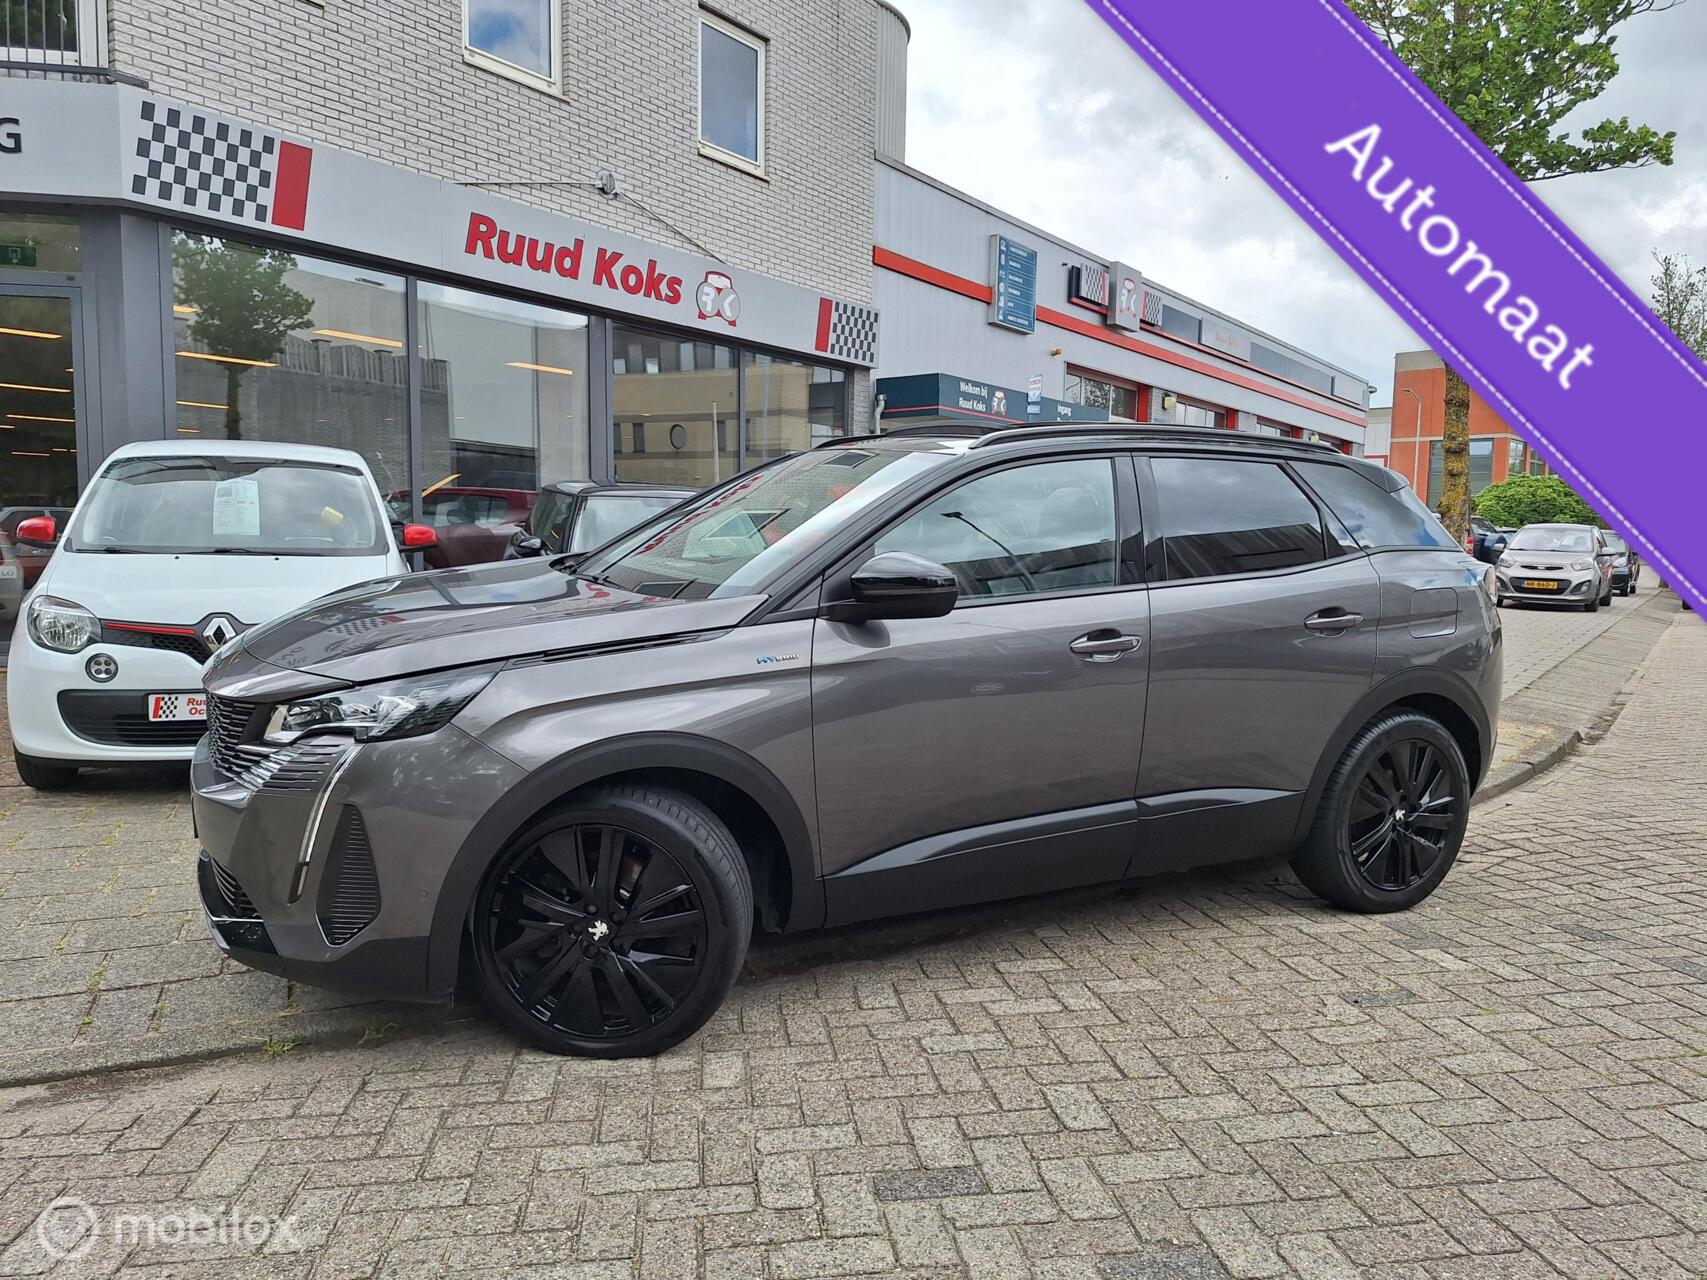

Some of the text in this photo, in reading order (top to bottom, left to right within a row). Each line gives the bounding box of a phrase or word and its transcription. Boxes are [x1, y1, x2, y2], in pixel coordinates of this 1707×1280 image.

[465, 212, 683, 305] Ruud Koks
[959, 381, 981, 396] Welkom
[958, 397, 986, 412] Ruud Koks
[1057, 403, 1072, 417] Ingang
